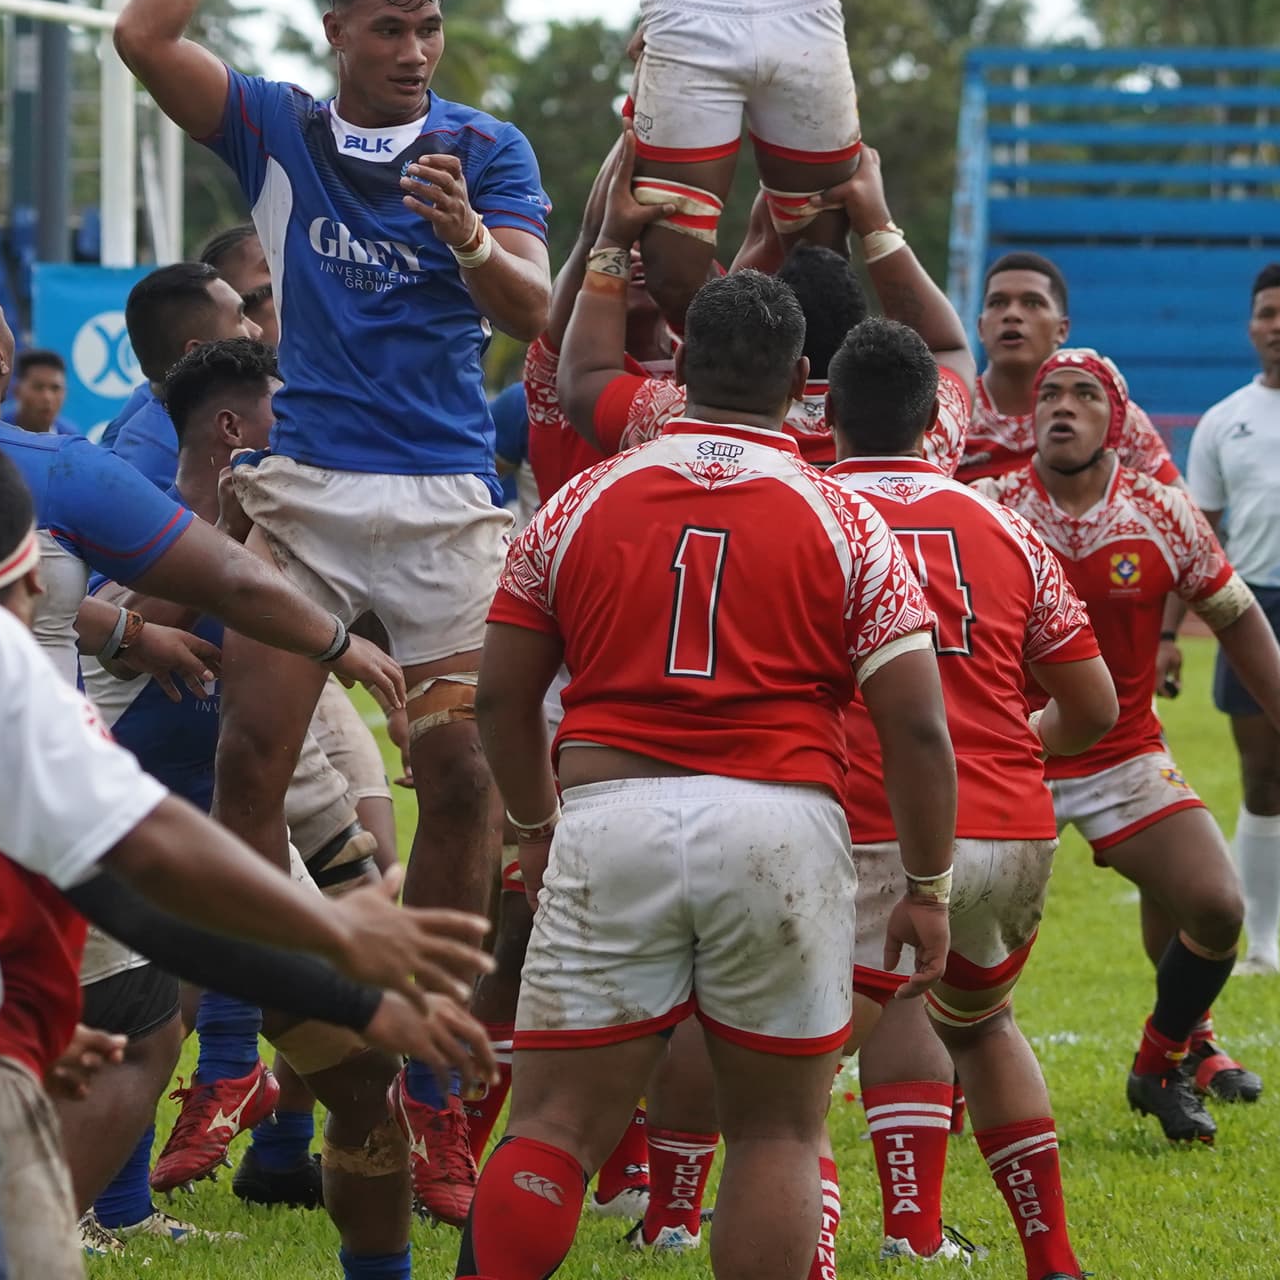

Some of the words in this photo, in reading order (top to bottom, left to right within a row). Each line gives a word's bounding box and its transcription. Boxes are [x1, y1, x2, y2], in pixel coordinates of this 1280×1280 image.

[343, 134, 394, 153] BLK
[320, 262, 419, 284] INVESTMENT
[344, 277, 393, 293] GROUP
[697, 440, 744, 458] SMP
[665, 524, 730, 680] 1
[666, 1151, 702, 1210] TONGA
[885, 1133, 921, 1215] TONGA
[1006, 1159, 1050, 1238] TONGA
